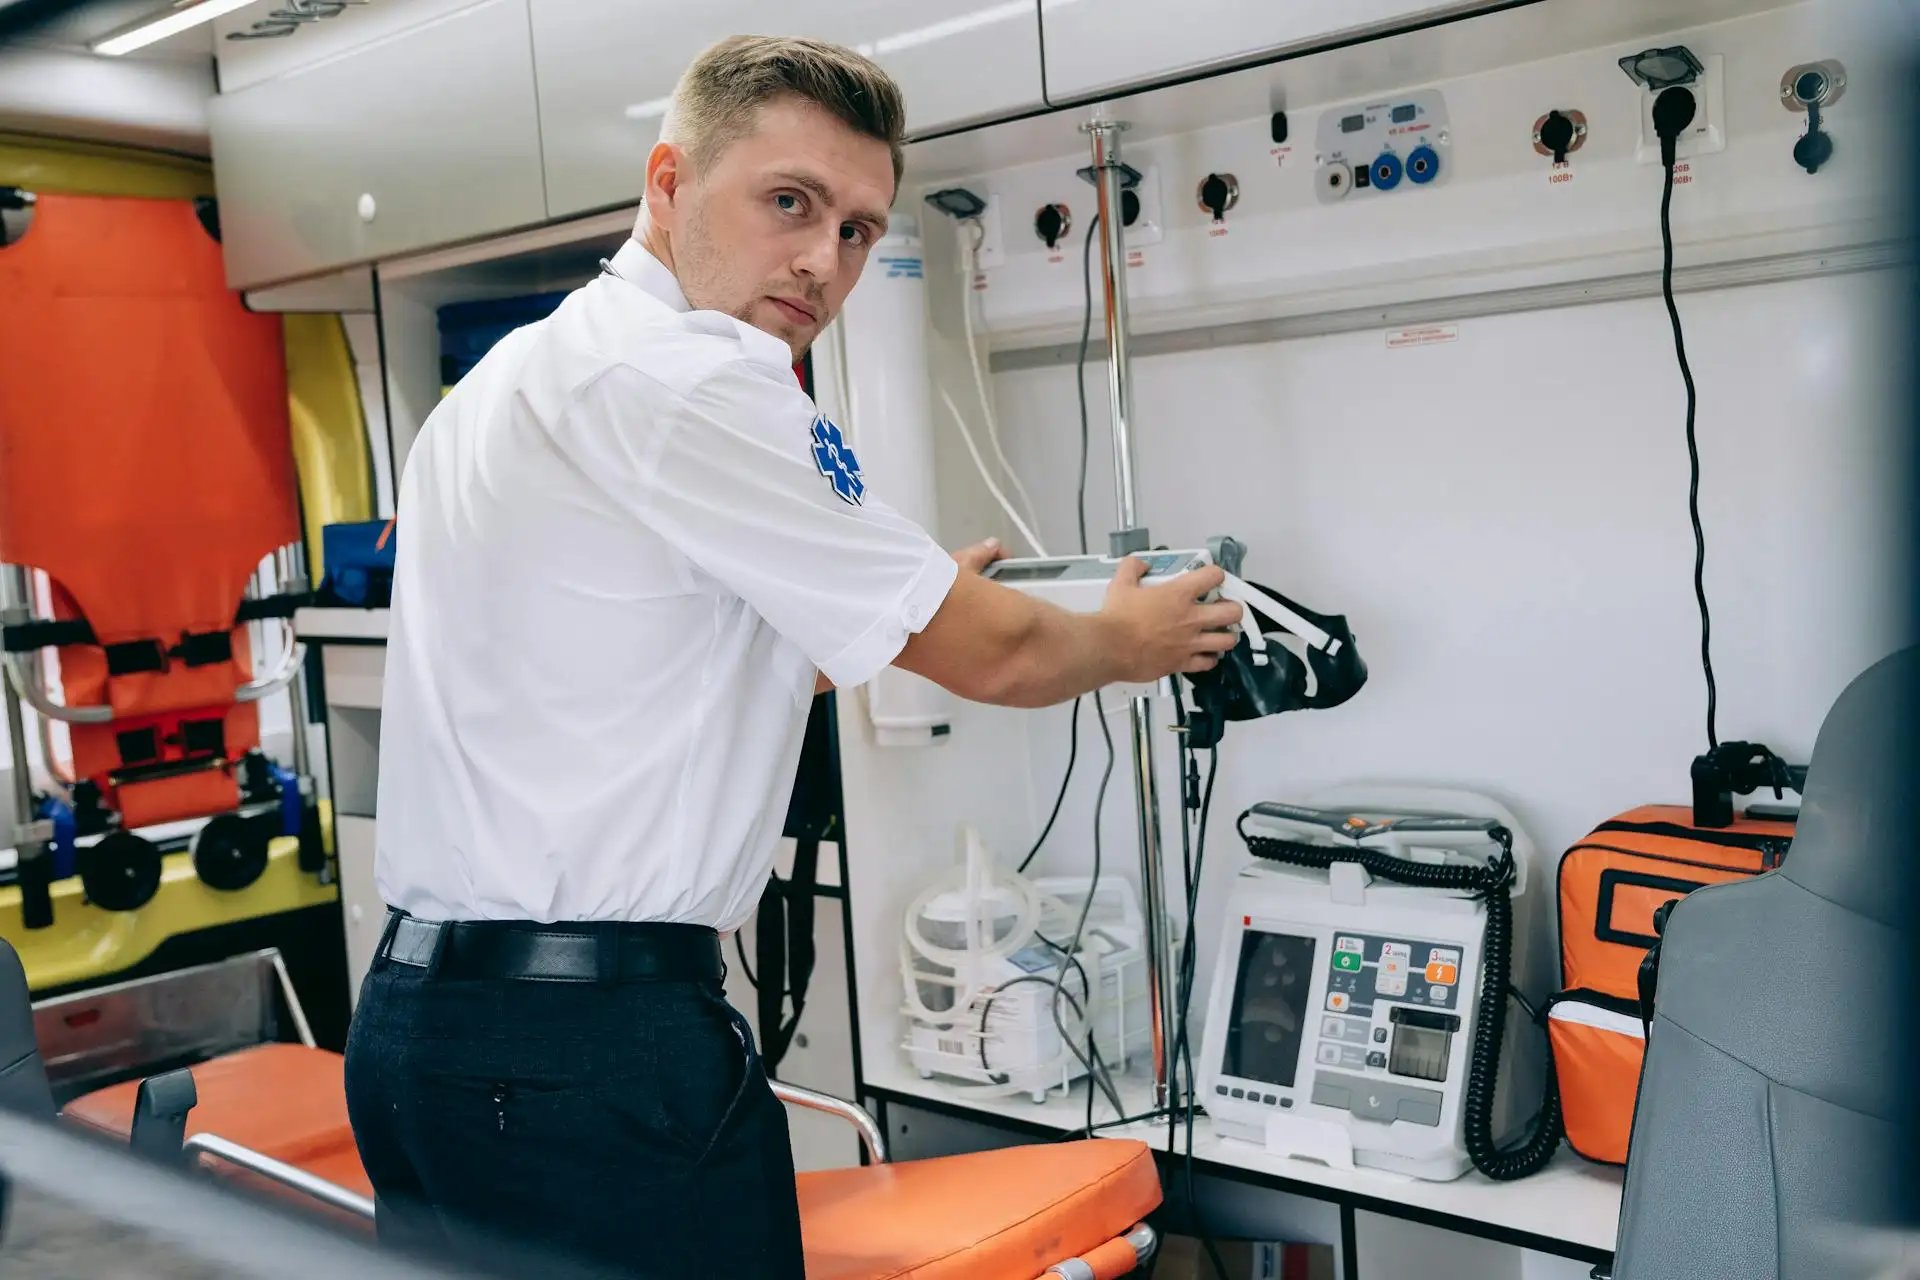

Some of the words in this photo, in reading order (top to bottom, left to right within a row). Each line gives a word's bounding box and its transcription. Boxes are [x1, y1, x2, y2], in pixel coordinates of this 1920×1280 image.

[1549, 173, 1573, 184] 100Вт
[1339, 938, 1345, 949] 1
[1384, 944, 1392, 955] 2
[1431, 950, 1439, 961] 3
